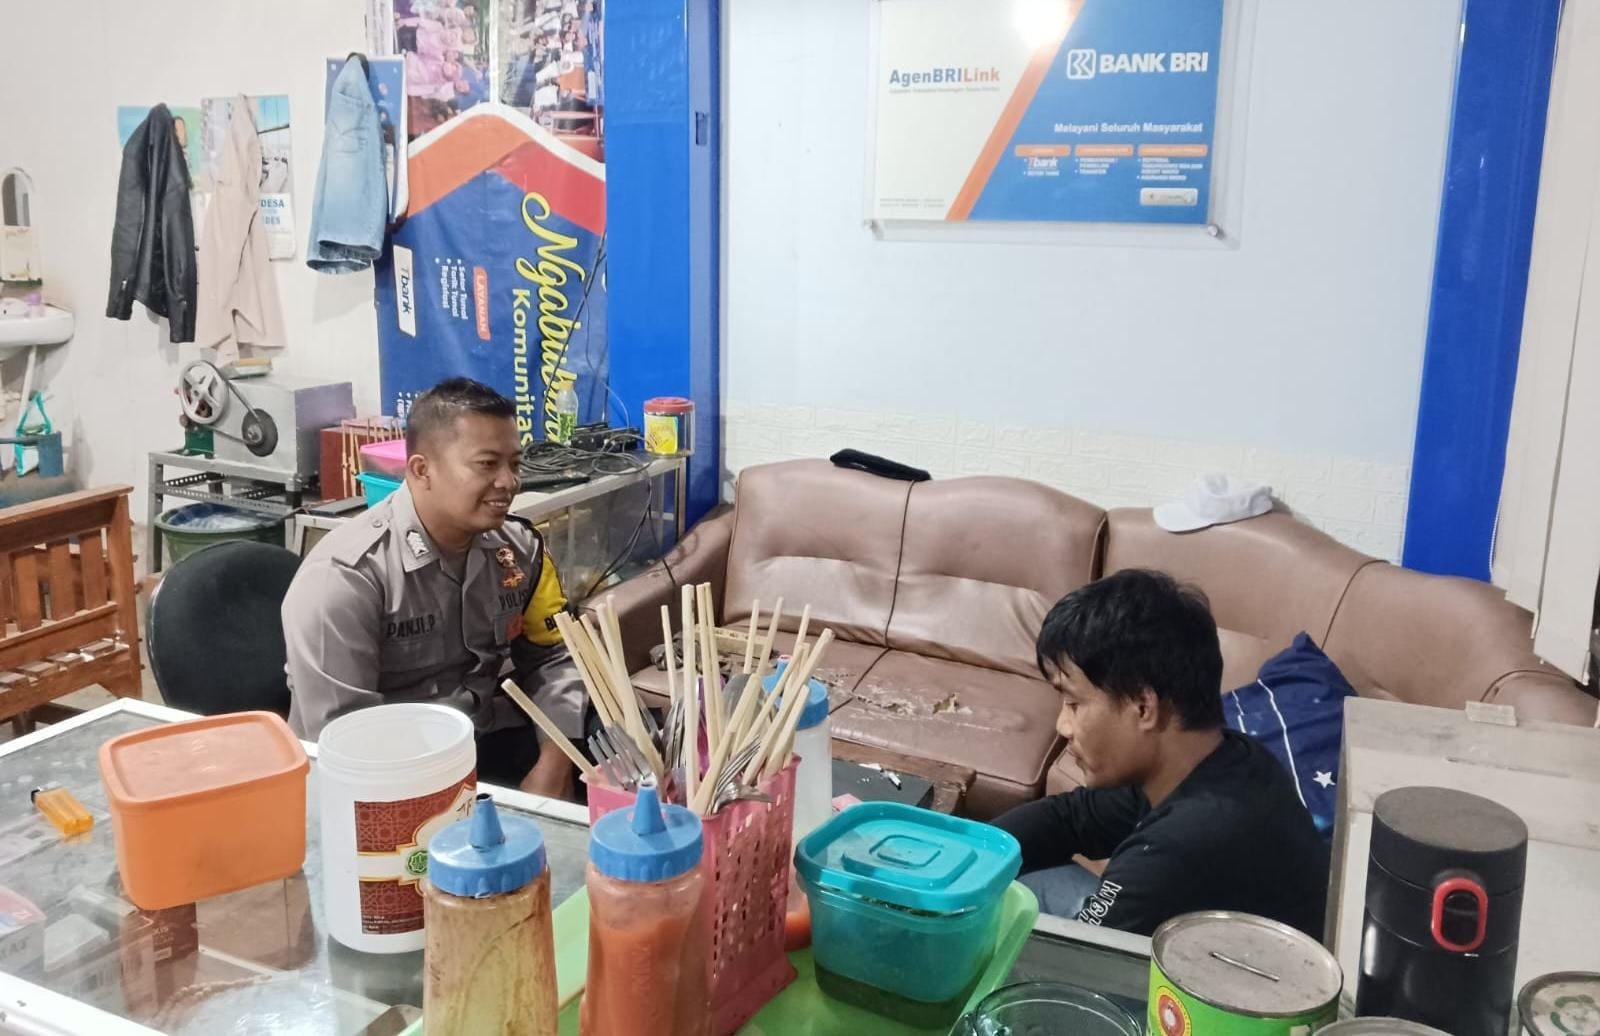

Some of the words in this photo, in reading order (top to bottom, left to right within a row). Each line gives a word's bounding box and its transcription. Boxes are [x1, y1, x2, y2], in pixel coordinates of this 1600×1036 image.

[1099, 53, 1166, 73] BANK
[1170, 52, 1209, 72] BRI
[889, 68, 1000, 87] AgenBRILink
[1054, 122, 1098, 134] Melayani
[1143, 122, 1203, 135] Masyarakat
[476, 274, 486, 334] LAYANAN
[512, 288, 535, 448] Komunitas
